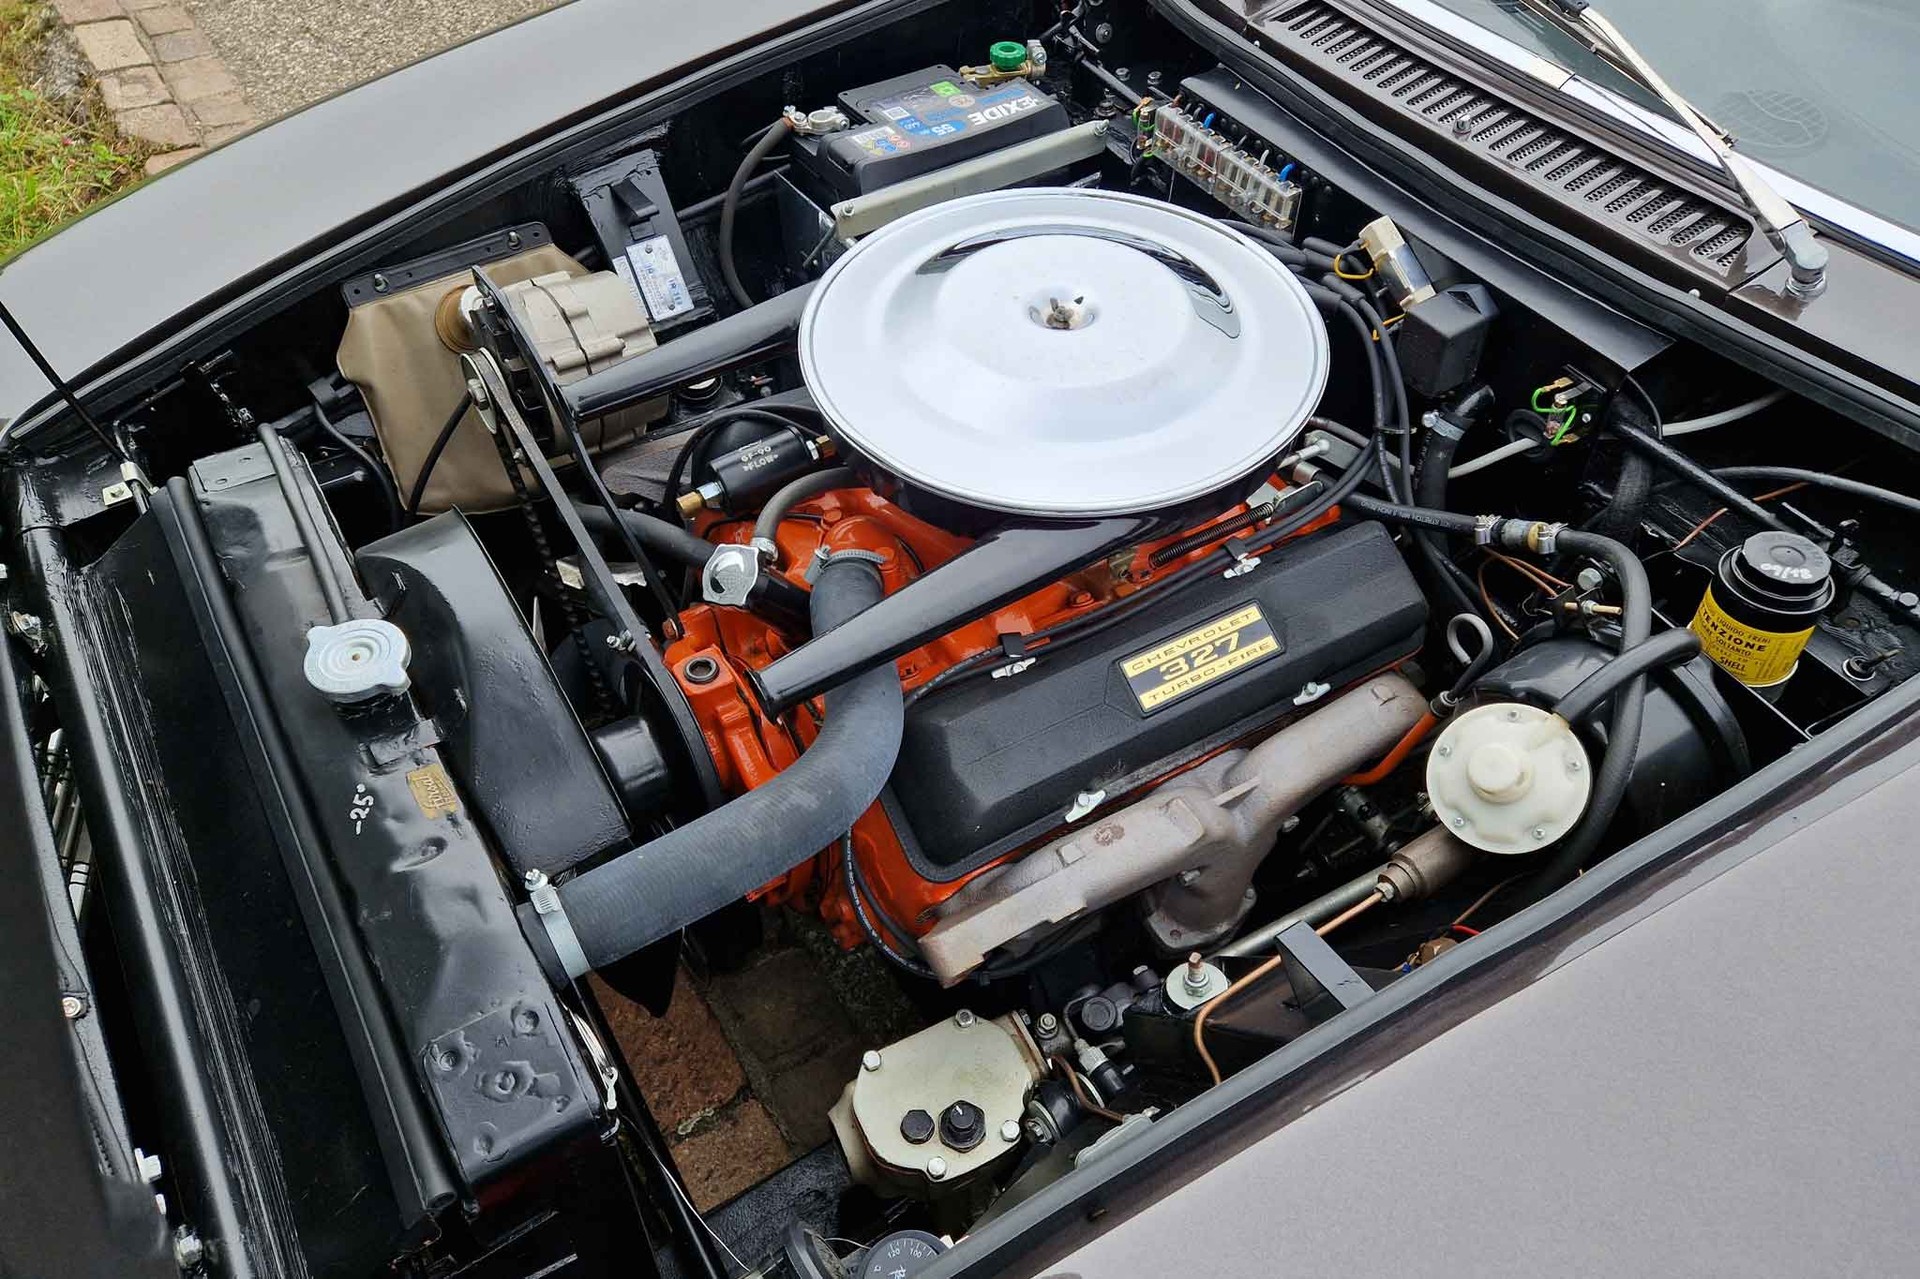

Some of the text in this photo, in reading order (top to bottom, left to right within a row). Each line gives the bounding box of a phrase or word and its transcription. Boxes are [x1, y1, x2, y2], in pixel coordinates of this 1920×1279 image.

[967, 95, 1036, 126] EXIDE
[1131, 611, 1254, 671] CHEVROLET
[1159, 631, 1240, 681] 327
[1148, 641, 1271, 701] TURBO-FIRE
[1719, 656, 1746, 672] SHELL
[887, 1248, 900, 1258] 120
[910, 1248, 922, 1258] 100
